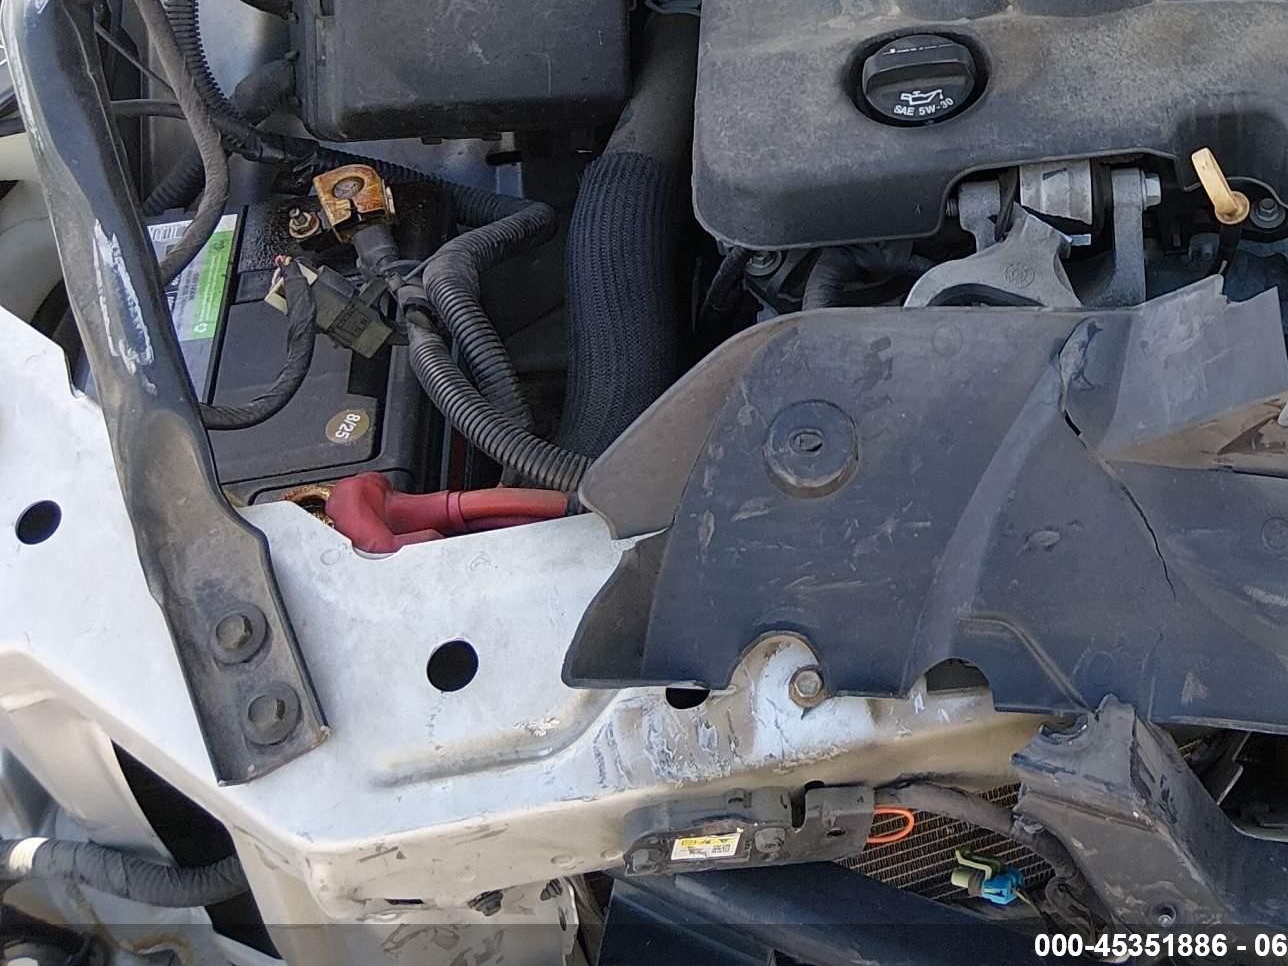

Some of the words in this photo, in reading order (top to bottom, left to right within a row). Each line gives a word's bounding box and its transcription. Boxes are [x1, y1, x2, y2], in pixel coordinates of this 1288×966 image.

[894, 105, 915, 116] SAE
[919, 97, 954, 116] 5W-30
[335, 413, 361, 439] 8/25
